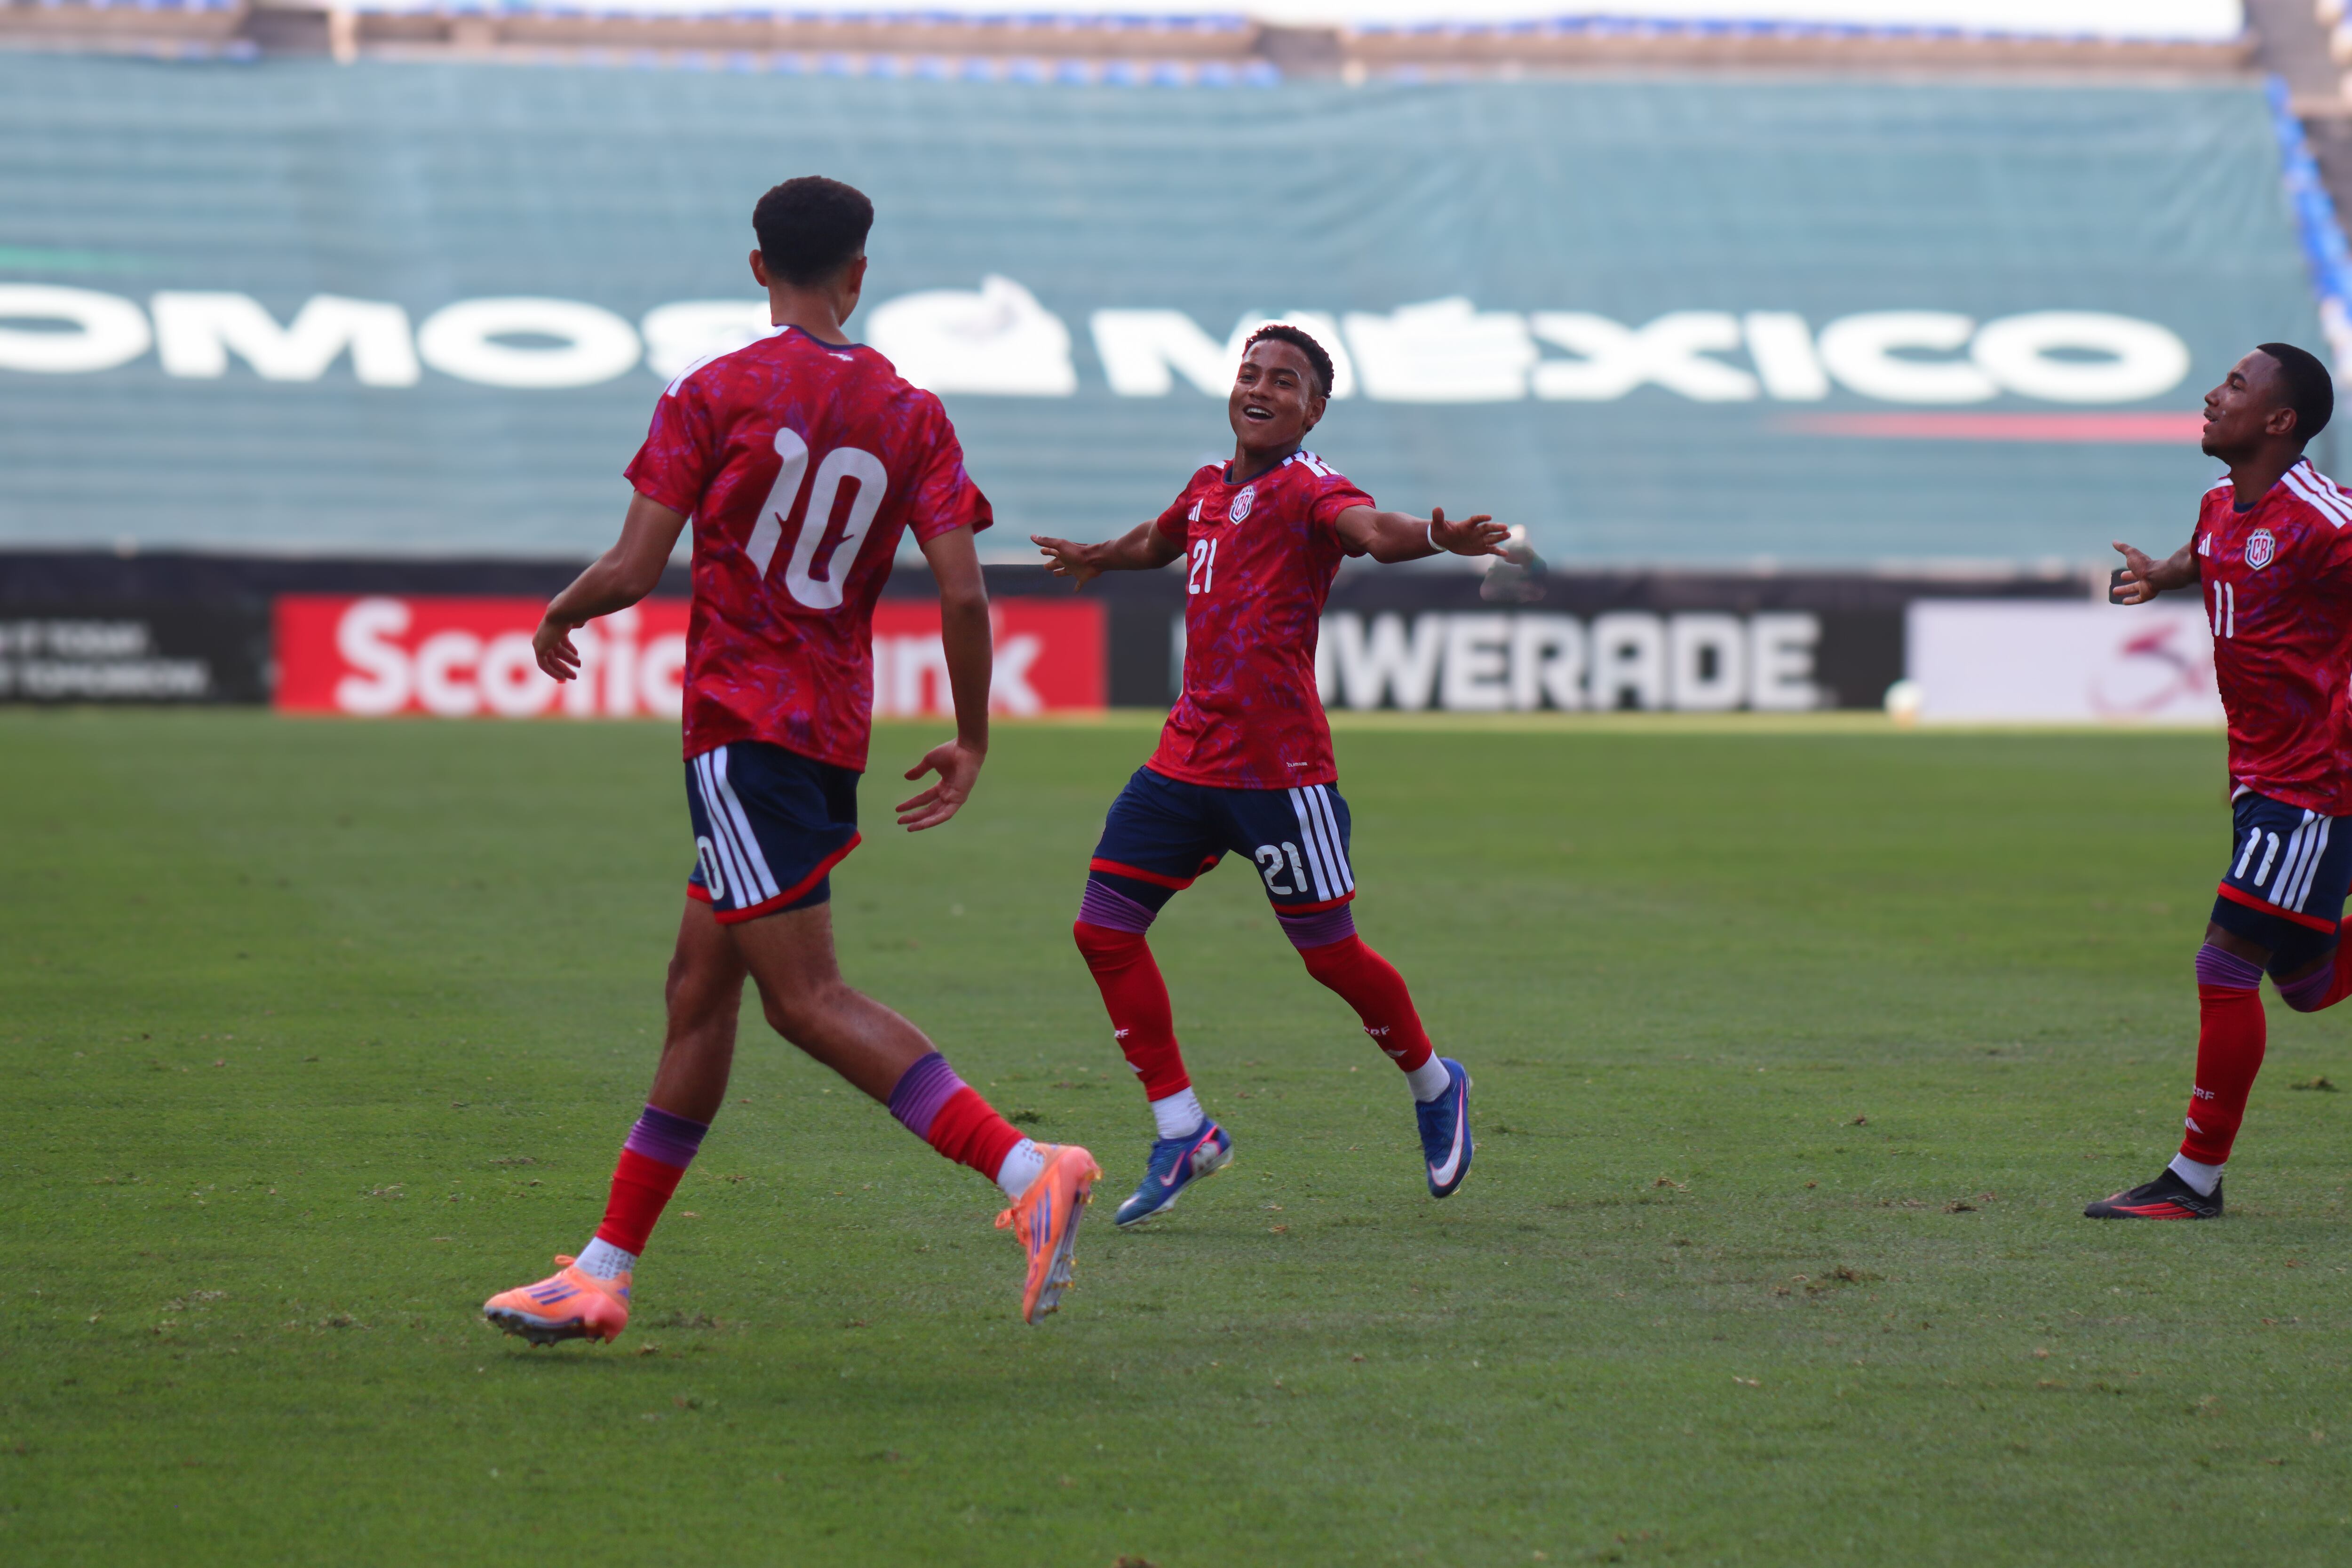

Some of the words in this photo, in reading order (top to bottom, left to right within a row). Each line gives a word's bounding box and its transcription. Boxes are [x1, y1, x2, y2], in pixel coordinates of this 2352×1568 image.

[746, 427, 888, 609] 10
[1189, 538, 1217, 594] 21
[2214, 580, 2233, 638] 11
[1172, 612, 1821, 709] WERADE
[1255, 842, 1308, 895] 21
[2234, 827, 2280, 887] 11
